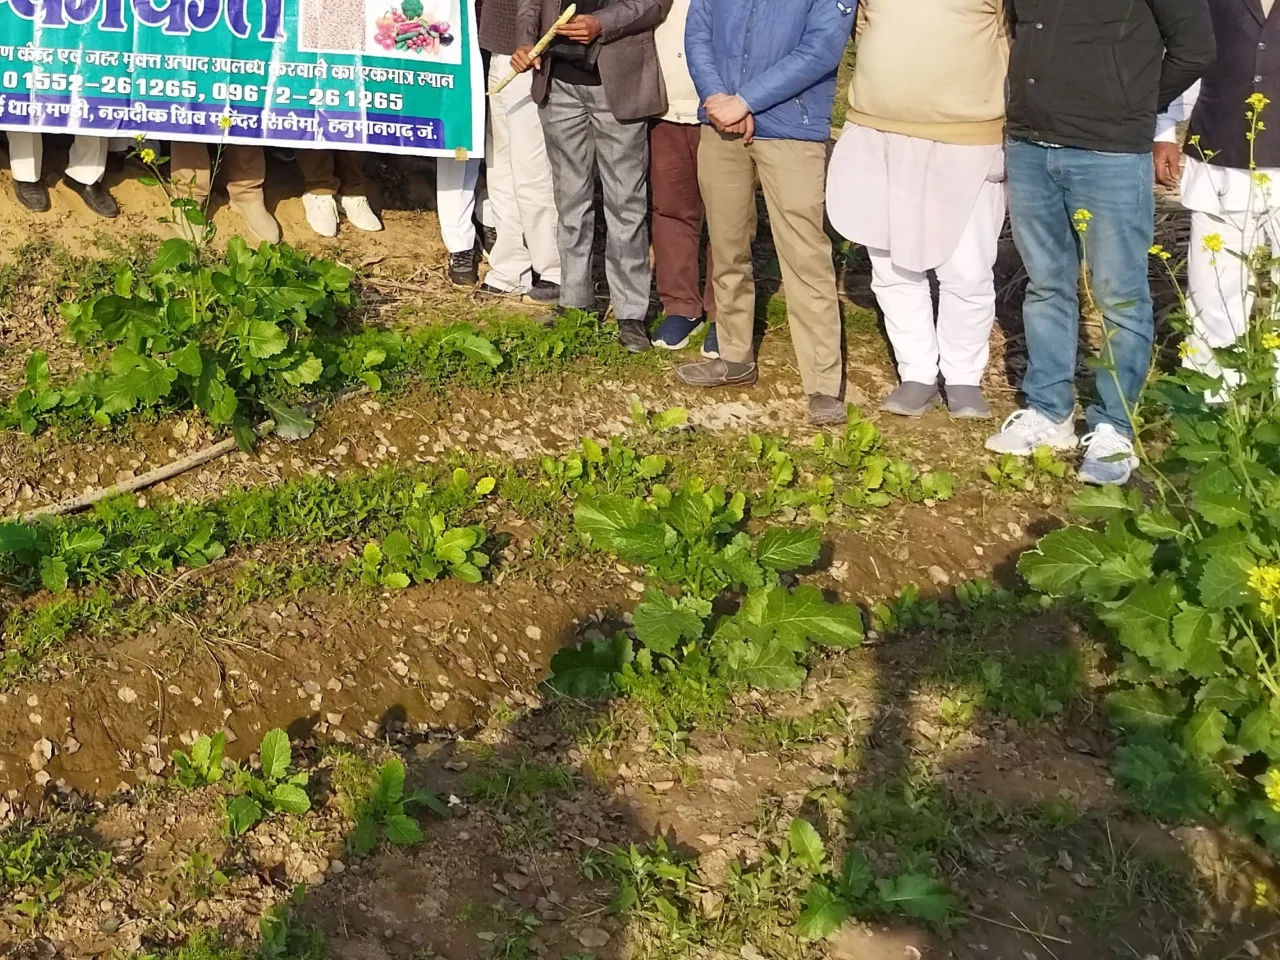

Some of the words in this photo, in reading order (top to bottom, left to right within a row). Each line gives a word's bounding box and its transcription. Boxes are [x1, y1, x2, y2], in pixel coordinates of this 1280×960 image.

[85, 50, 120, 67] जहर
[123, 53, 161, 73] मुक्त
[163, 54, 209, 74] उत्पाद
[211, 58, 265, 76] उपलब्ध
[331, 64, 355, 80] का
[418, 71, 455, 90] स्थान
[98, 101, 168, 123] नजदीक
[171, 104, 207, 125] शिव
